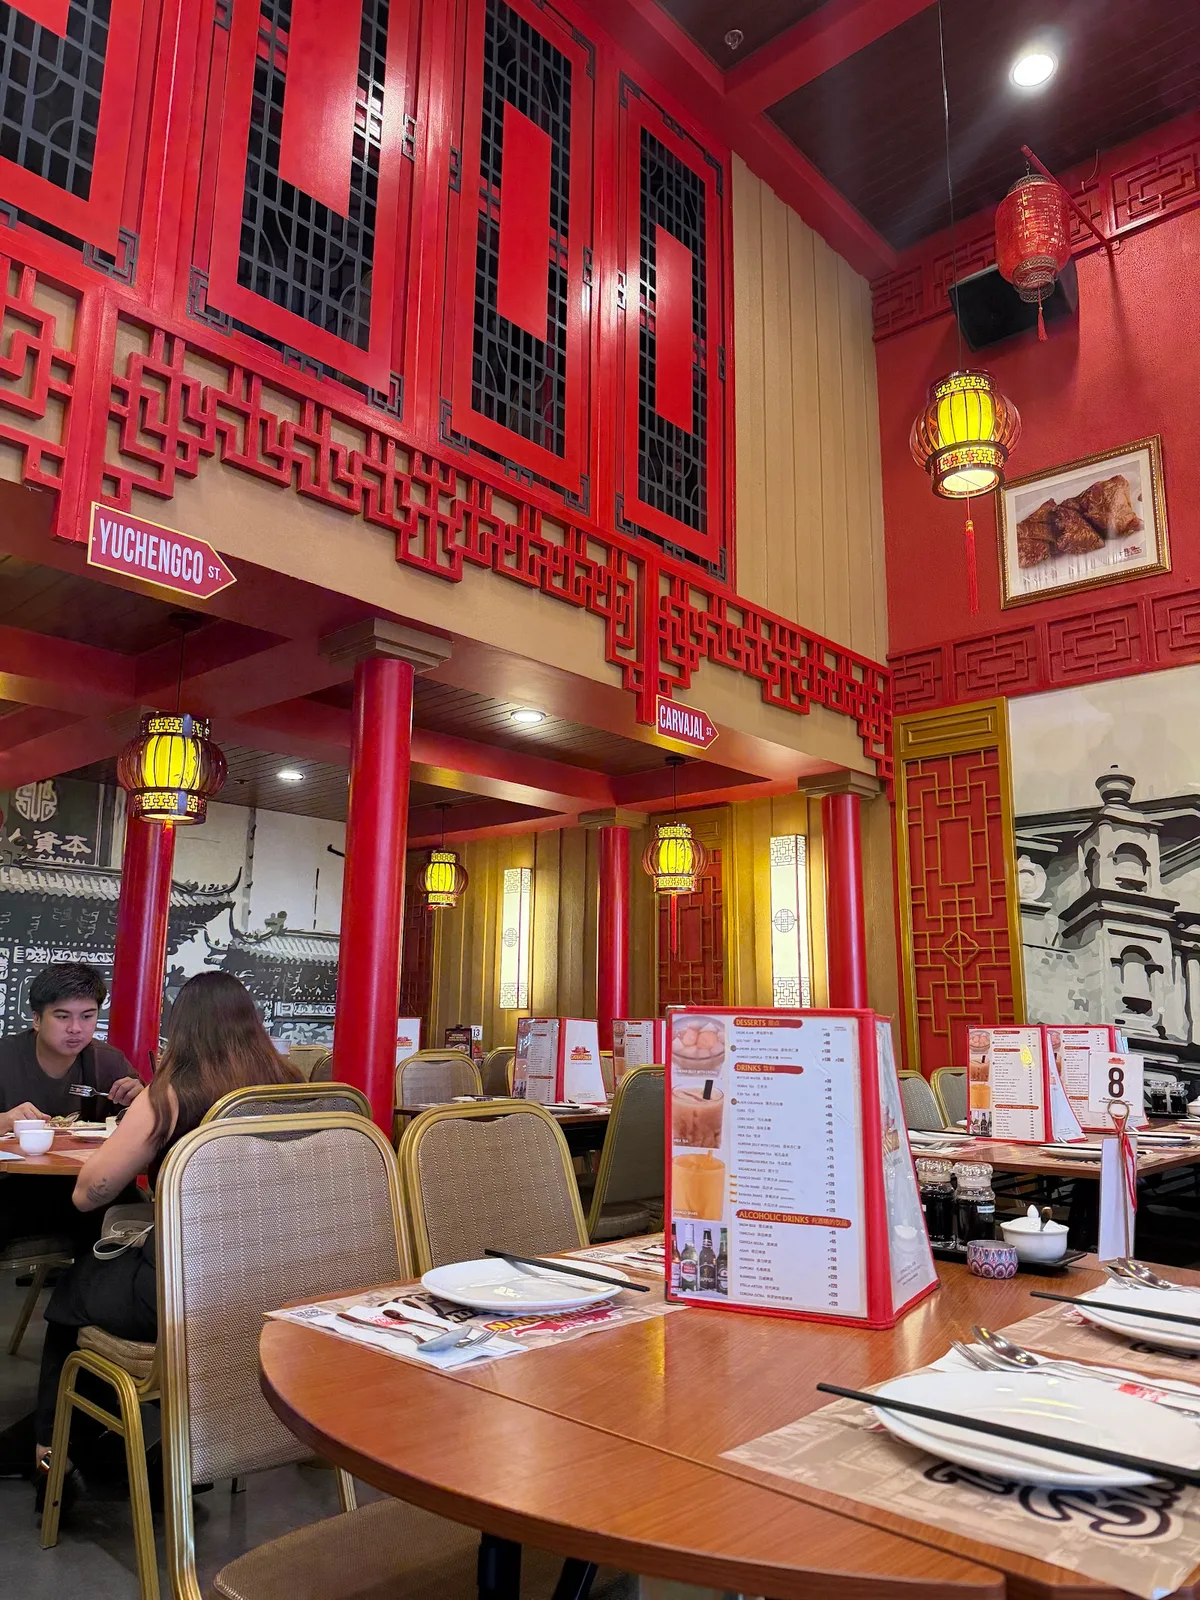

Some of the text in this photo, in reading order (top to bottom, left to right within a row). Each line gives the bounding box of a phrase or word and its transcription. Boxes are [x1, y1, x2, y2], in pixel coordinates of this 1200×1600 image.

[100, 518, 222, 584] YUCHENGCO ST.
[660, 704, 705, 741] CARVAJAL
[735, 1018, 766, 1027] DESSERTS
[473, 1028, 481, 1037] 13
[736, 1063, 761, 1072] DRINKS
[1108, 1067, 1124, 1098] 8
[739, 1211, 809, 1224] ALCOHOLIC DRINKS
